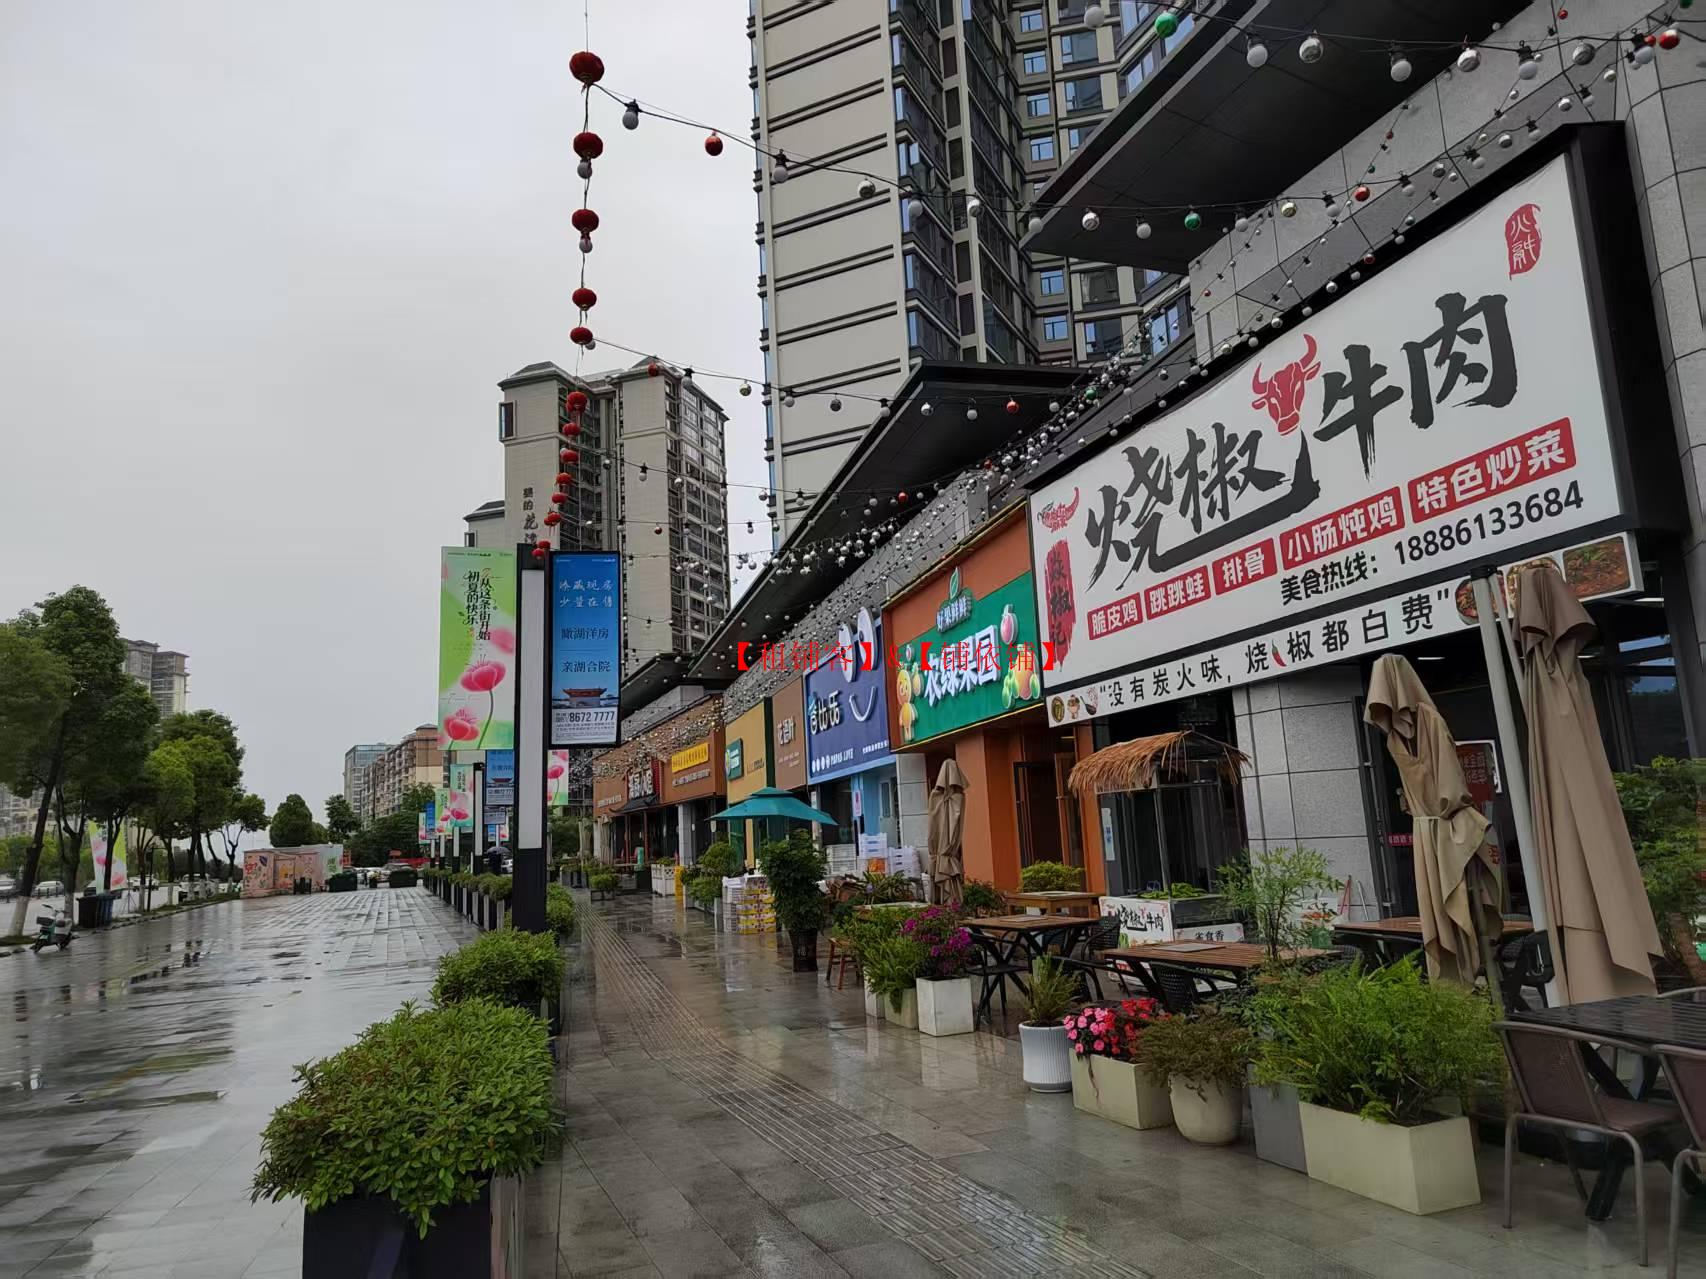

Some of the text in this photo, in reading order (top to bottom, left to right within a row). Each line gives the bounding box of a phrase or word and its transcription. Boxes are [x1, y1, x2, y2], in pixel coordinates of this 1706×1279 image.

[1085, 292, 1519, 591] 烧椒牛肉
[1091, 428, 1567, 636] 脆皮鸡 跳跳蛙 排骨 小肠炖鸡 特色炒菜
[1280, 480, 1584, 606] 美食热线： 18886133684
[463, 570, 480, 625] 初夏的快乐
[476, 577, 493, 641] 从这条街开始
[561, 660, 612, 673] 亲湖合院
[569, 711, 592, 723] 8672
[594, 710, 616, 722] 7777
